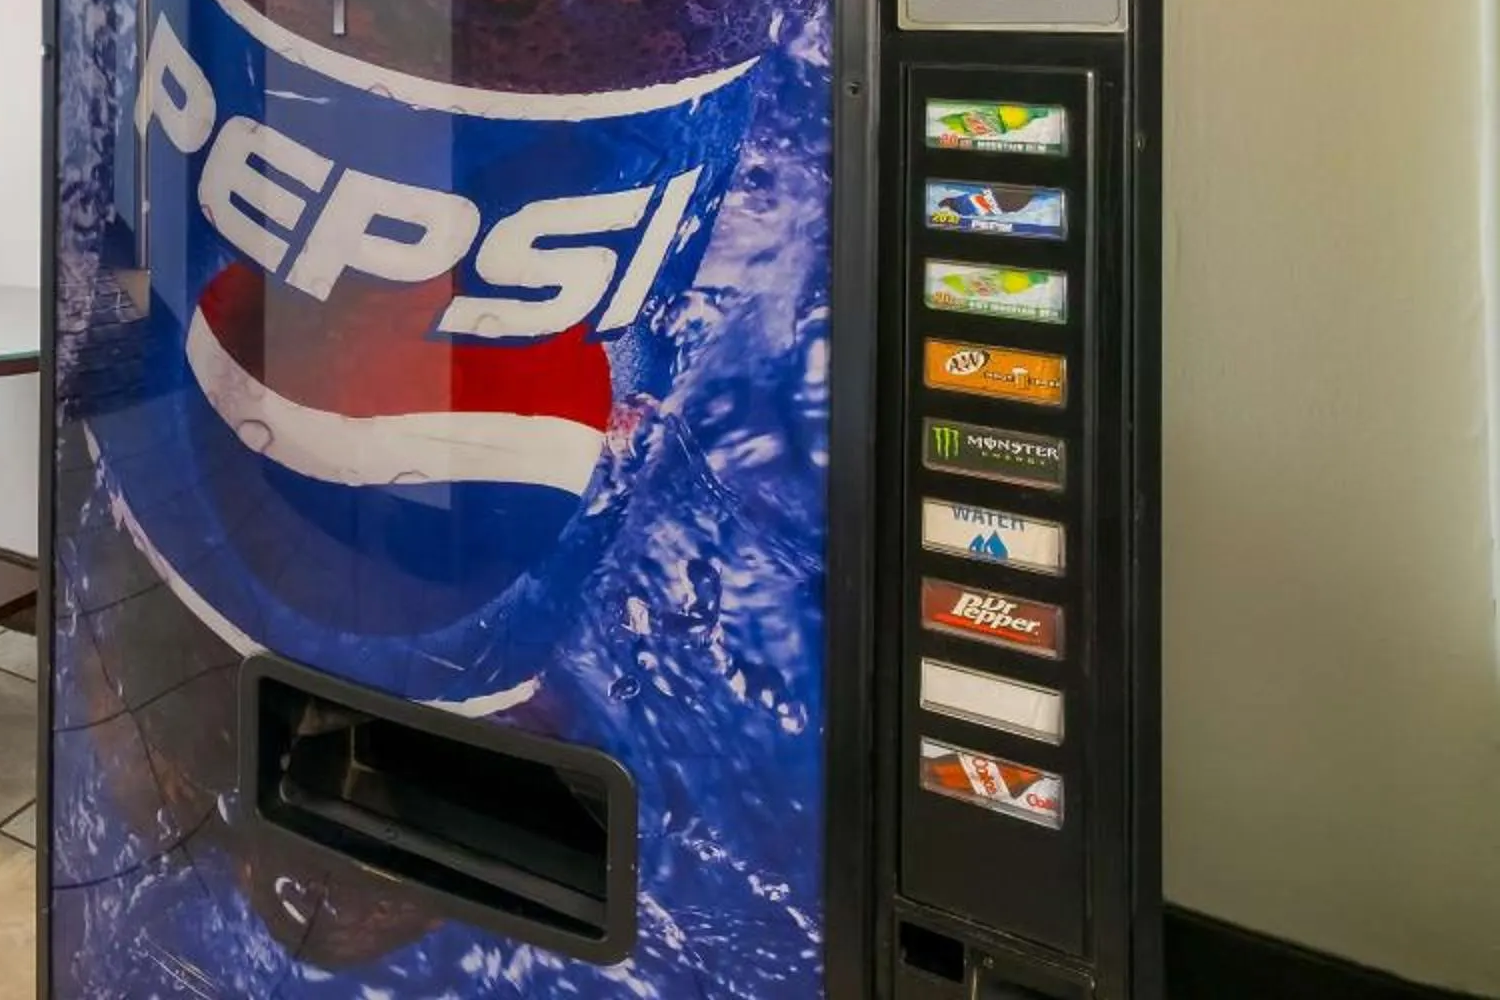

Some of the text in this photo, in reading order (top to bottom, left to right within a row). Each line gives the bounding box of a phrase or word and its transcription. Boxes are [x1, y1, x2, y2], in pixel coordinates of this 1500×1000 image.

[134, 10, 703, 339] PEPSI
[967, 434, 1059, 461] MONSTER
[951, 504, 1027, 532] WATER
[952, 592, 1041, 634] Pepper
[981, 595, 1018, 614] Dr
